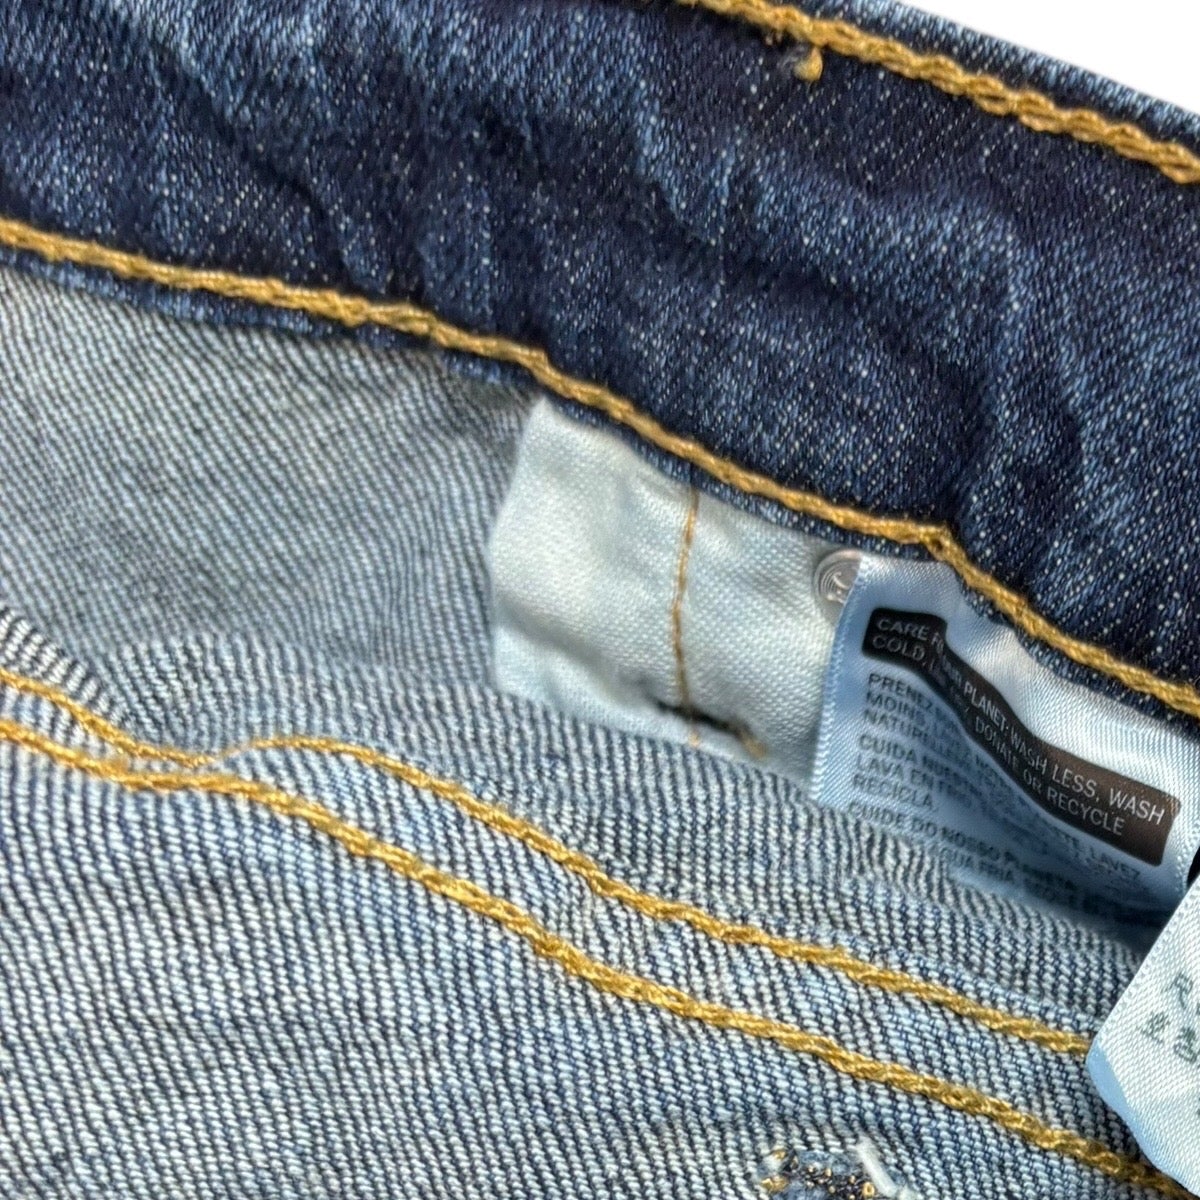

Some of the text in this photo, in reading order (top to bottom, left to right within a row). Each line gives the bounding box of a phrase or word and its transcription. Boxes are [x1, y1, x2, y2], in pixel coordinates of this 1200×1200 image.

[875, 617, 929, 641] CARE
[1048, 763, 1106, 802] LESS,
[1103, 786, 1167, 826] WASH
[1019, 767, 1045, 793] OR
[1043, 785, 1128, 836] RECYCLE
